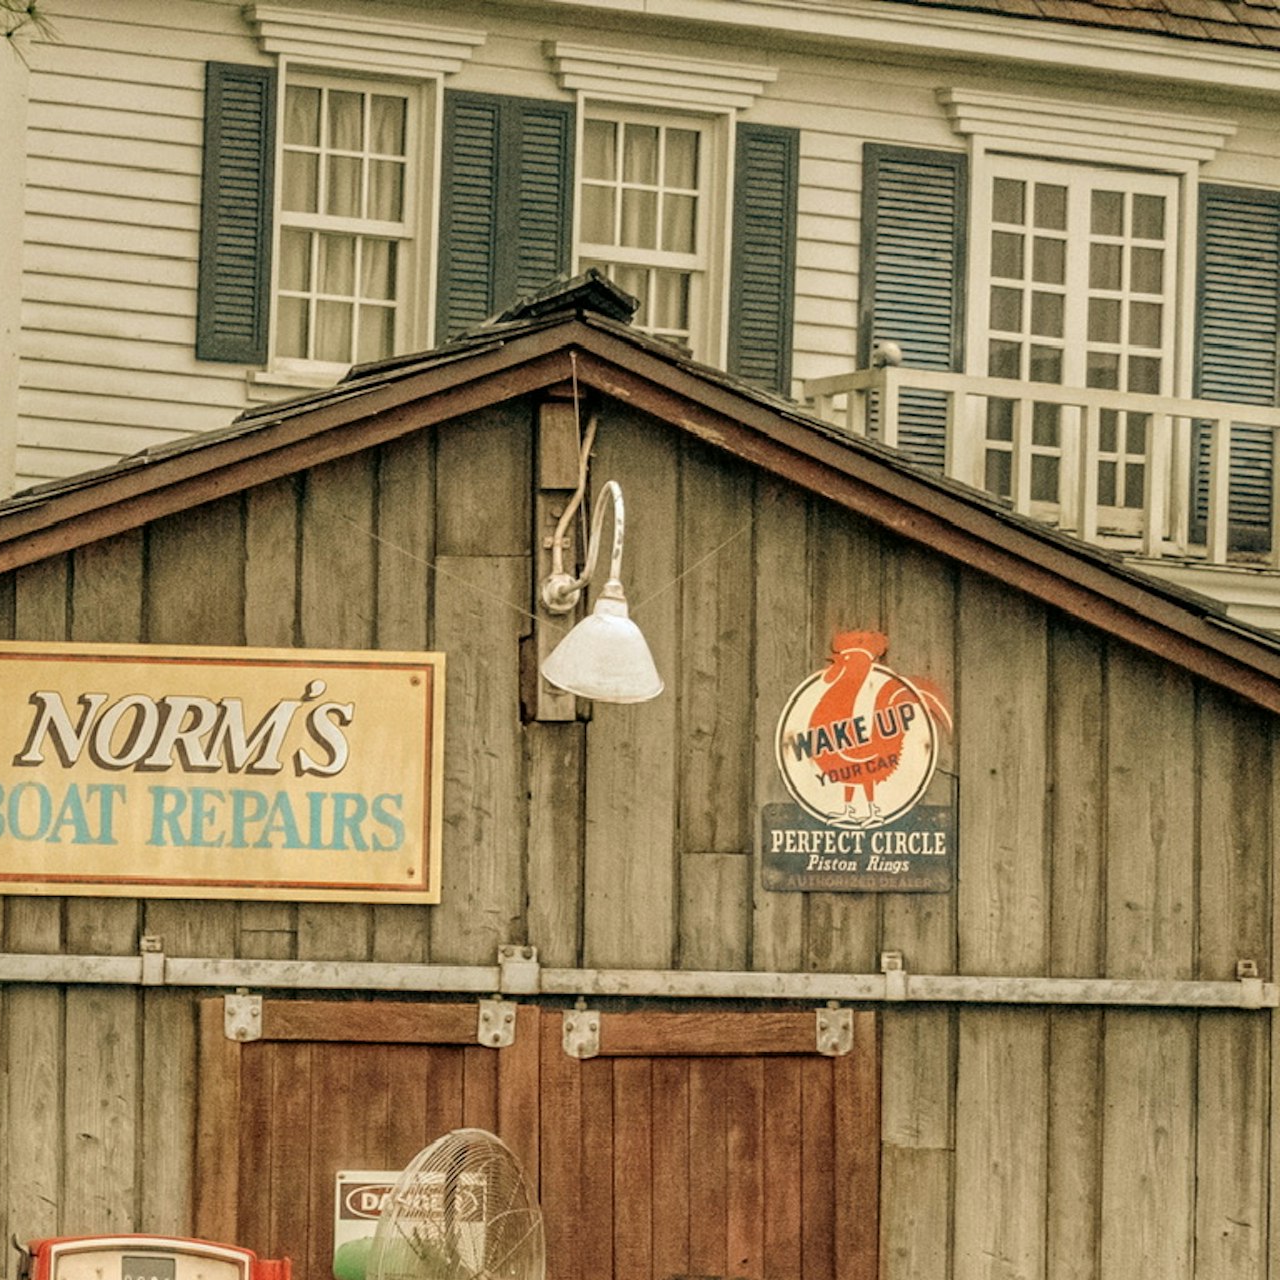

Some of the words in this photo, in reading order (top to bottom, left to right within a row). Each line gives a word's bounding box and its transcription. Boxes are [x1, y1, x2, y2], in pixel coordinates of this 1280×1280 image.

[12, 680, 355, 777] NORM'S
[791, 716, 869, 761] WAKE
[877, 703, 915, 737] UP
[815, 763, 862, 787] YOUR
[866, 754, 899, 774] CAR
[145, 785, 406, 853] REPAIRS
[771, 829, 865, 854] PERFECT
[871, 831, 946, 855] CIRCLE
[807, 854, 857, 872] Piston
[866, 855, 910, 874] Rings
